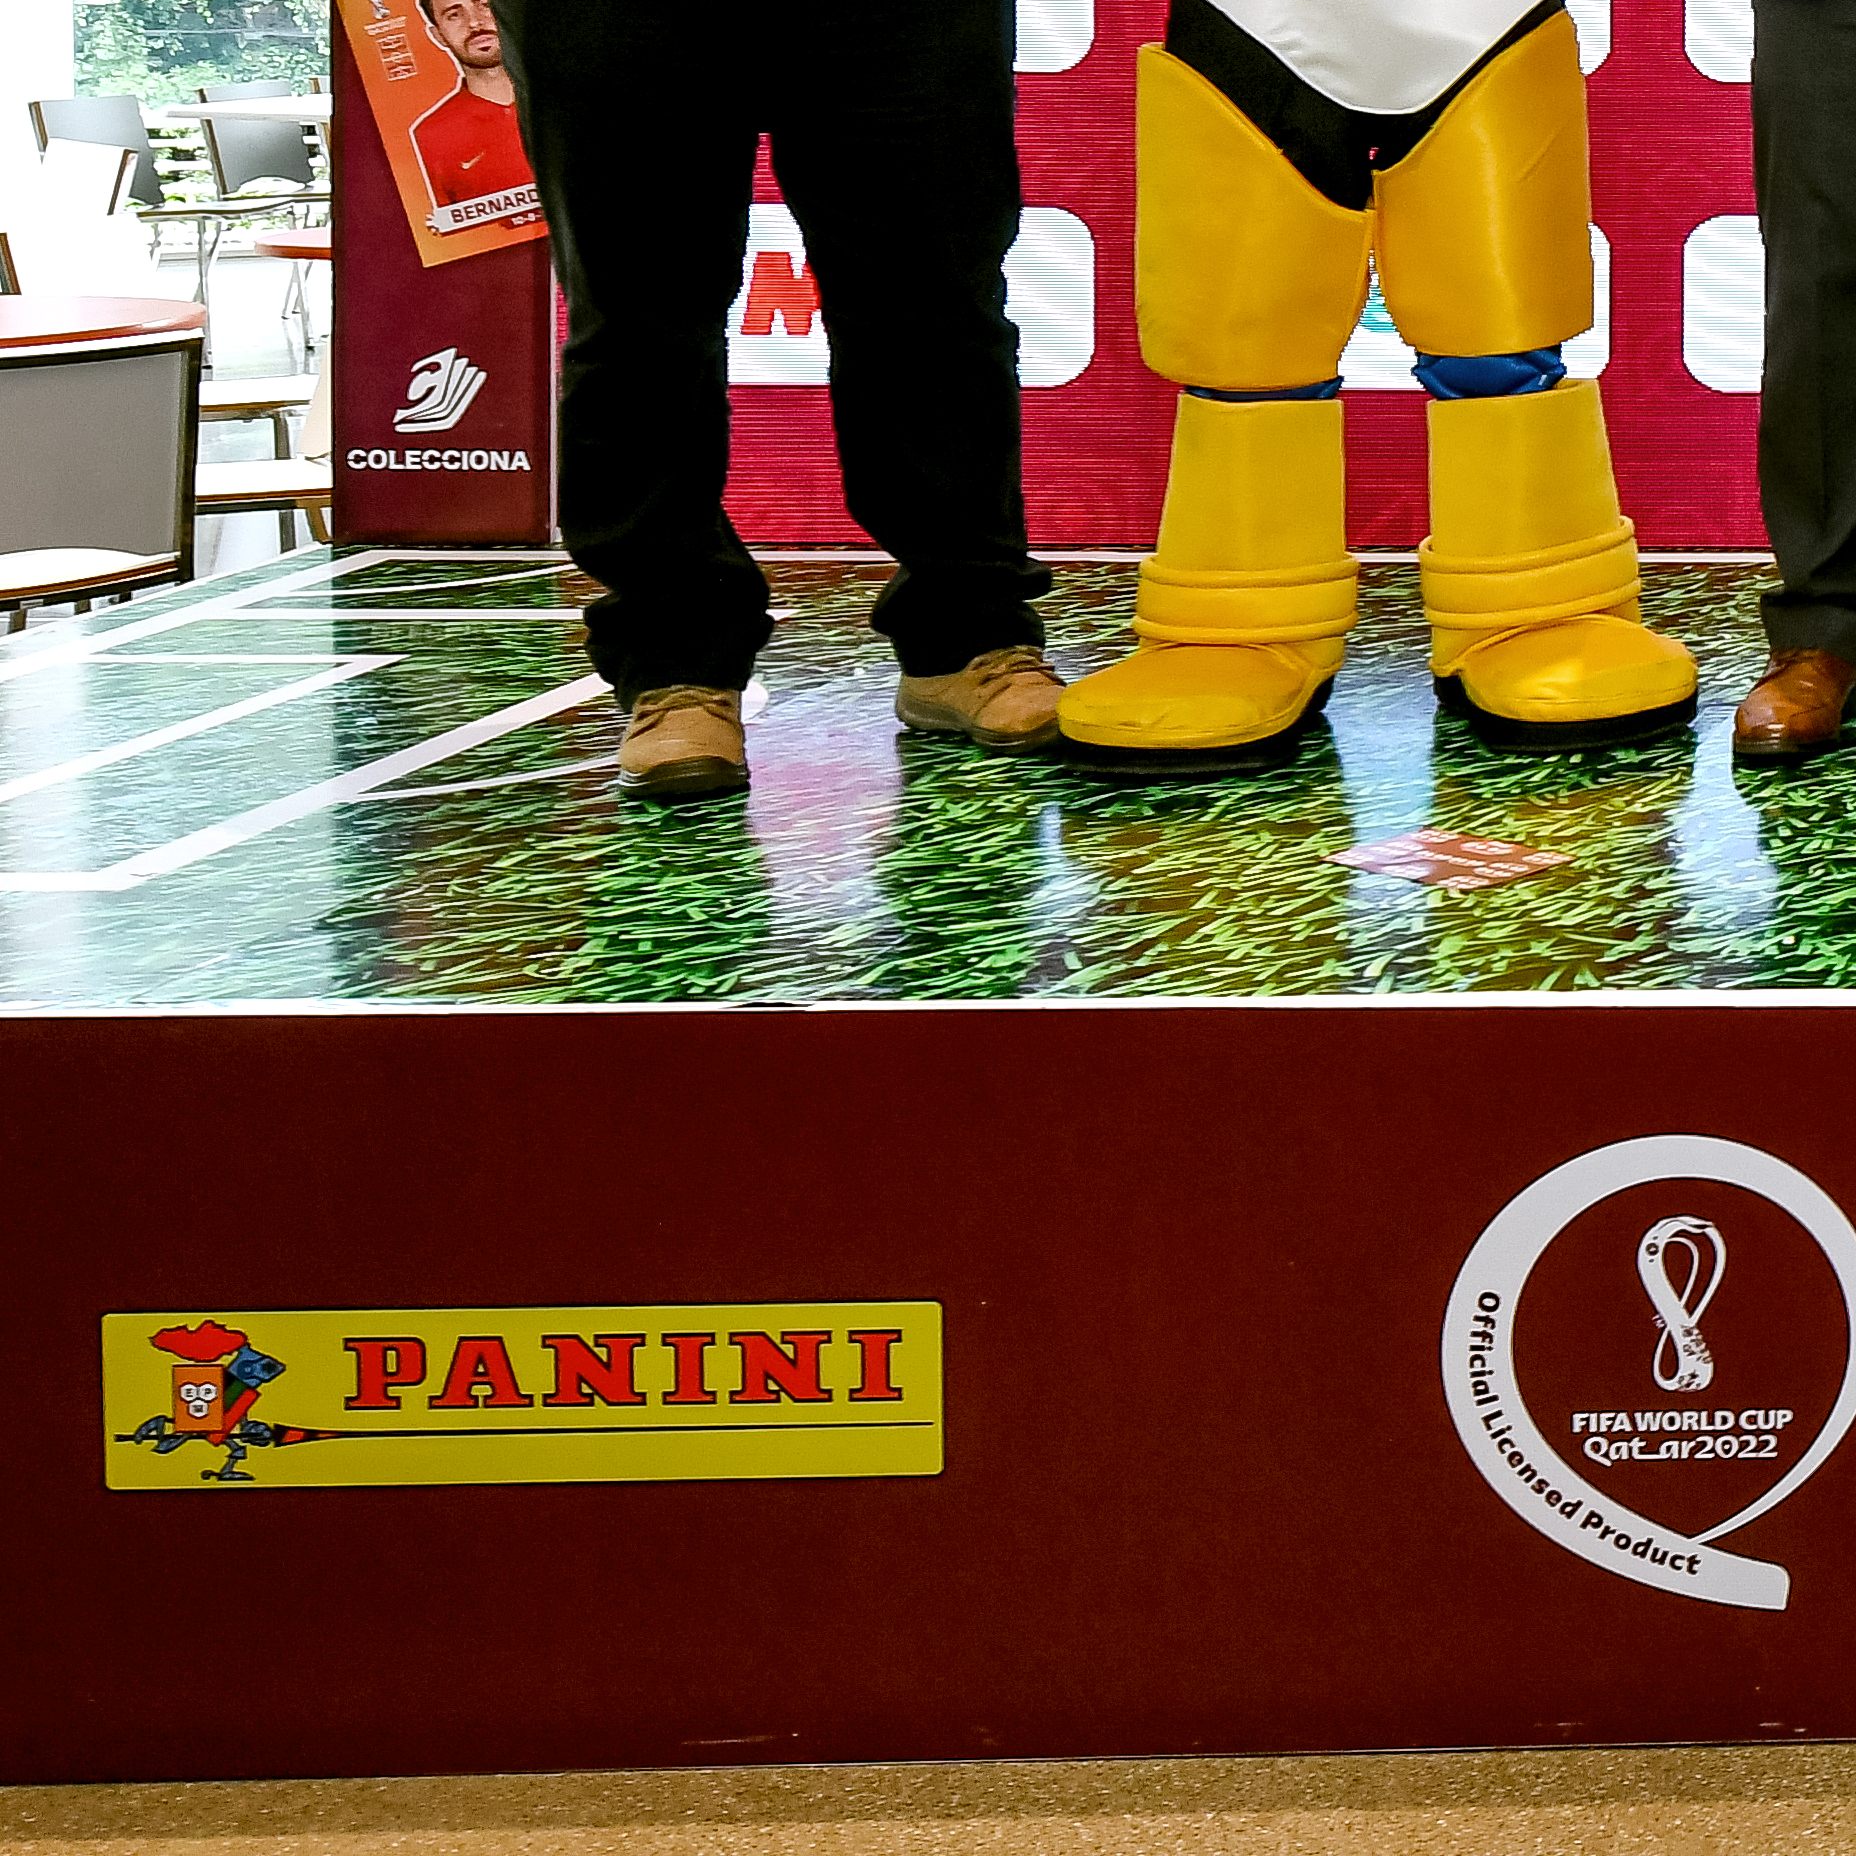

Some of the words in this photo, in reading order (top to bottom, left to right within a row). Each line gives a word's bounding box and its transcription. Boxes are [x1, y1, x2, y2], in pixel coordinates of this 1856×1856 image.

[451, 188, 540, 225] BERNARD
[346, 448, 532, 472] COLECCIONA
[343, 1327, 905, 1411] PANINI
[1468, 1290, 1500, 1408] Official
[1571, 1410, 1632, 1434] FIFA
[1634, 1409, 1736, 1433] WORLD
[1738, 1408, 1795, 1431] CUP
[1481, 1397, 1582, 1520] Licensed
[1580, 1510, 1703, 1577] Product
